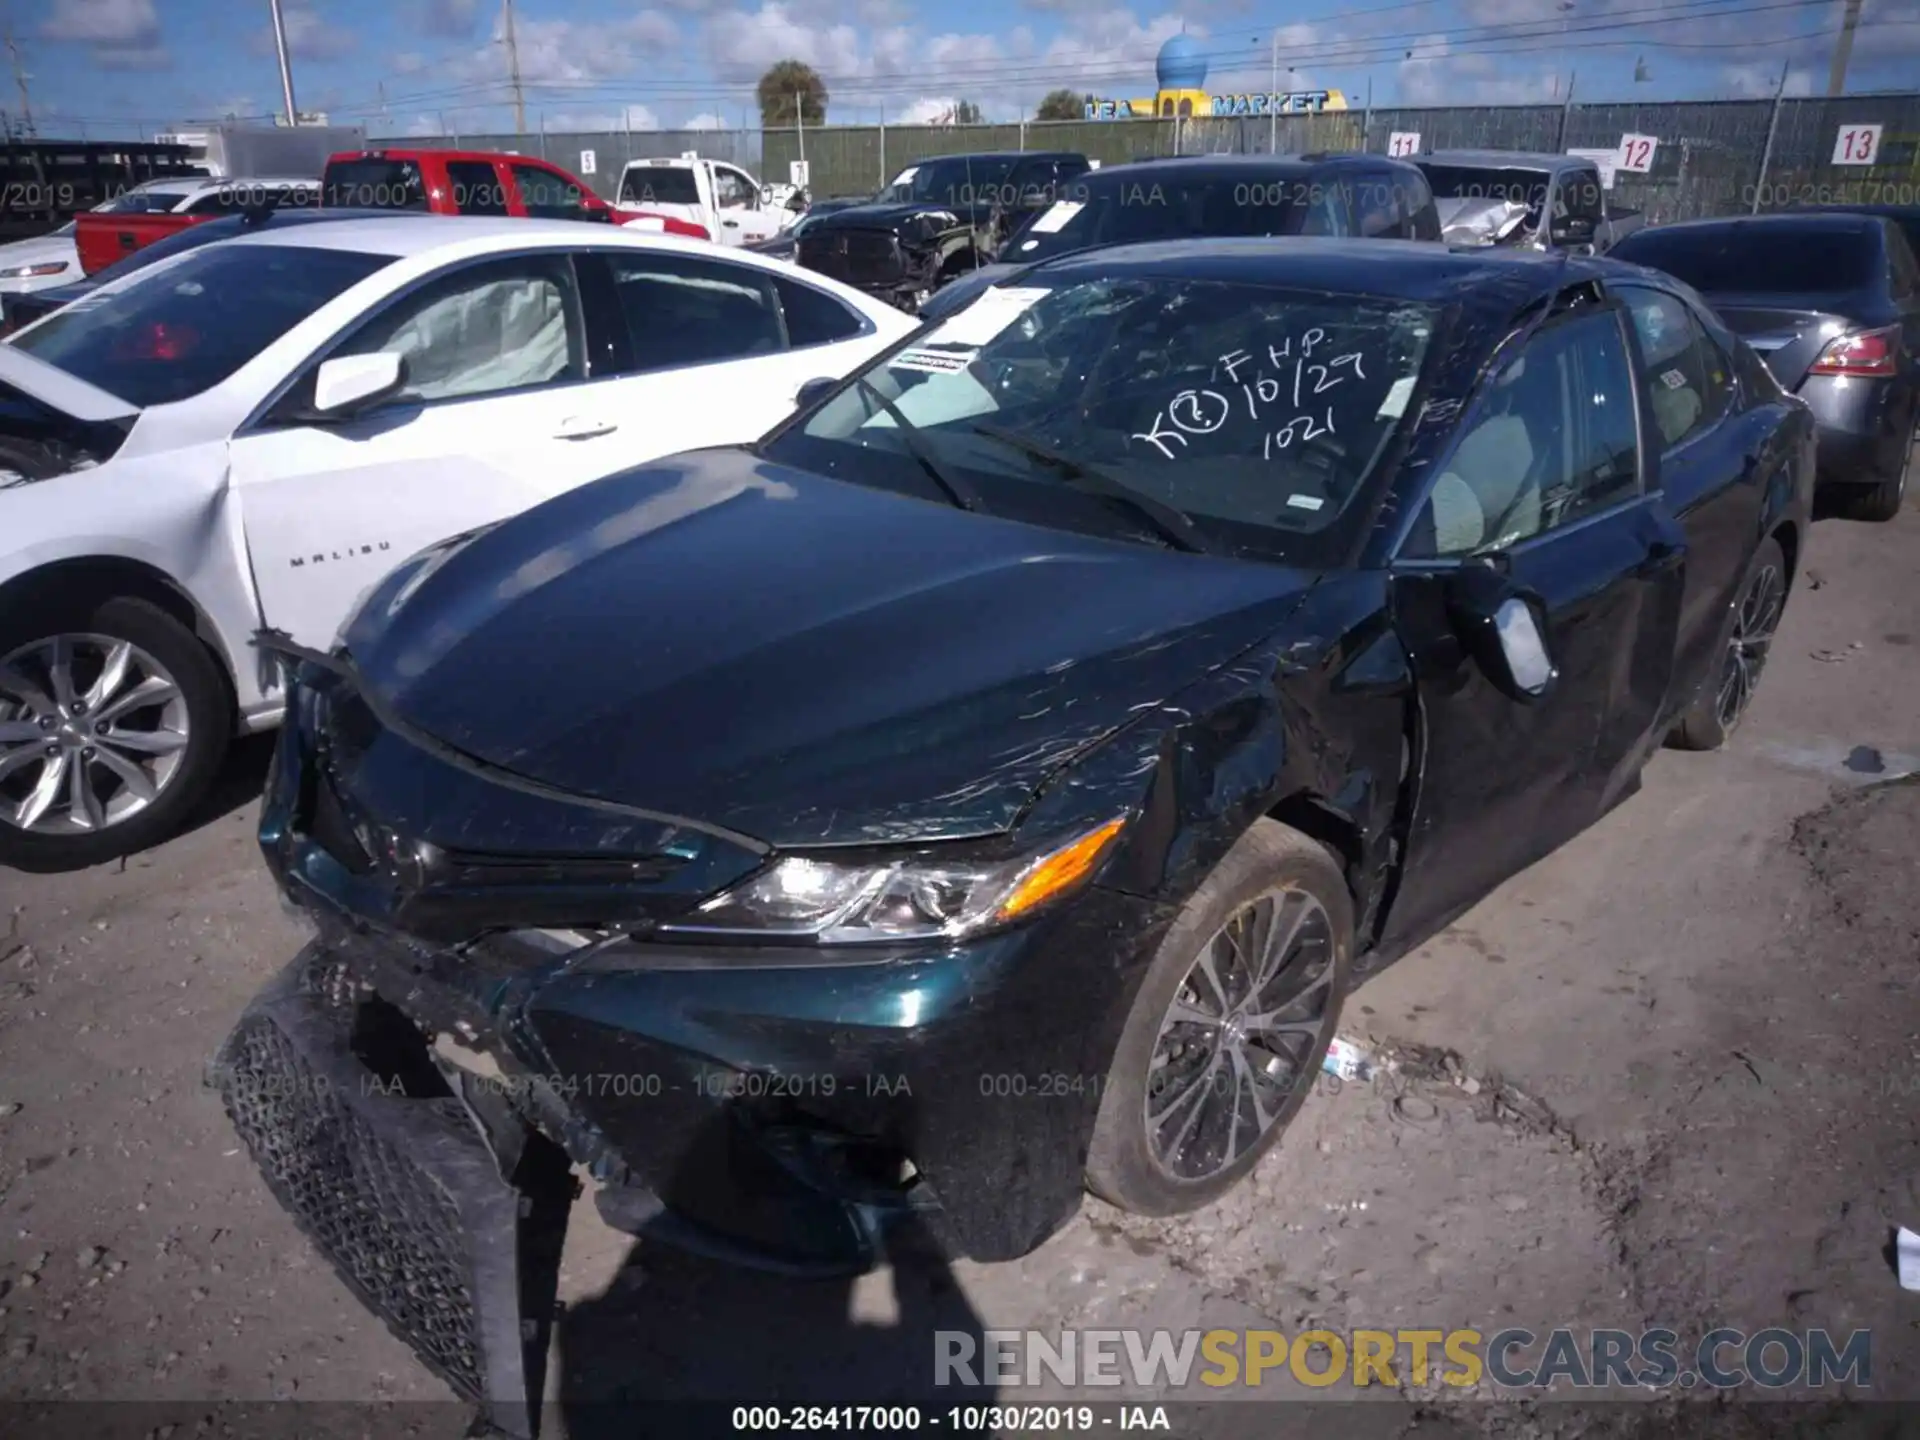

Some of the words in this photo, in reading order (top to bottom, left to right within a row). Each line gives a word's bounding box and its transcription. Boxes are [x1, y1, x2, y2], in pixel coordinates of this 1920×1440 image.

[1211, 91, 1329, 116] MARKET
[1395, 137, 1413, 157] 11
[1624, 140, 1651, 169] 12
[1842, 130, 1874, 160] 13
[1243, 352, 1366, 420] 10/29
[1264, 406, 1336, 460] 1021
[289, 541, 391, 568] MALIBU
